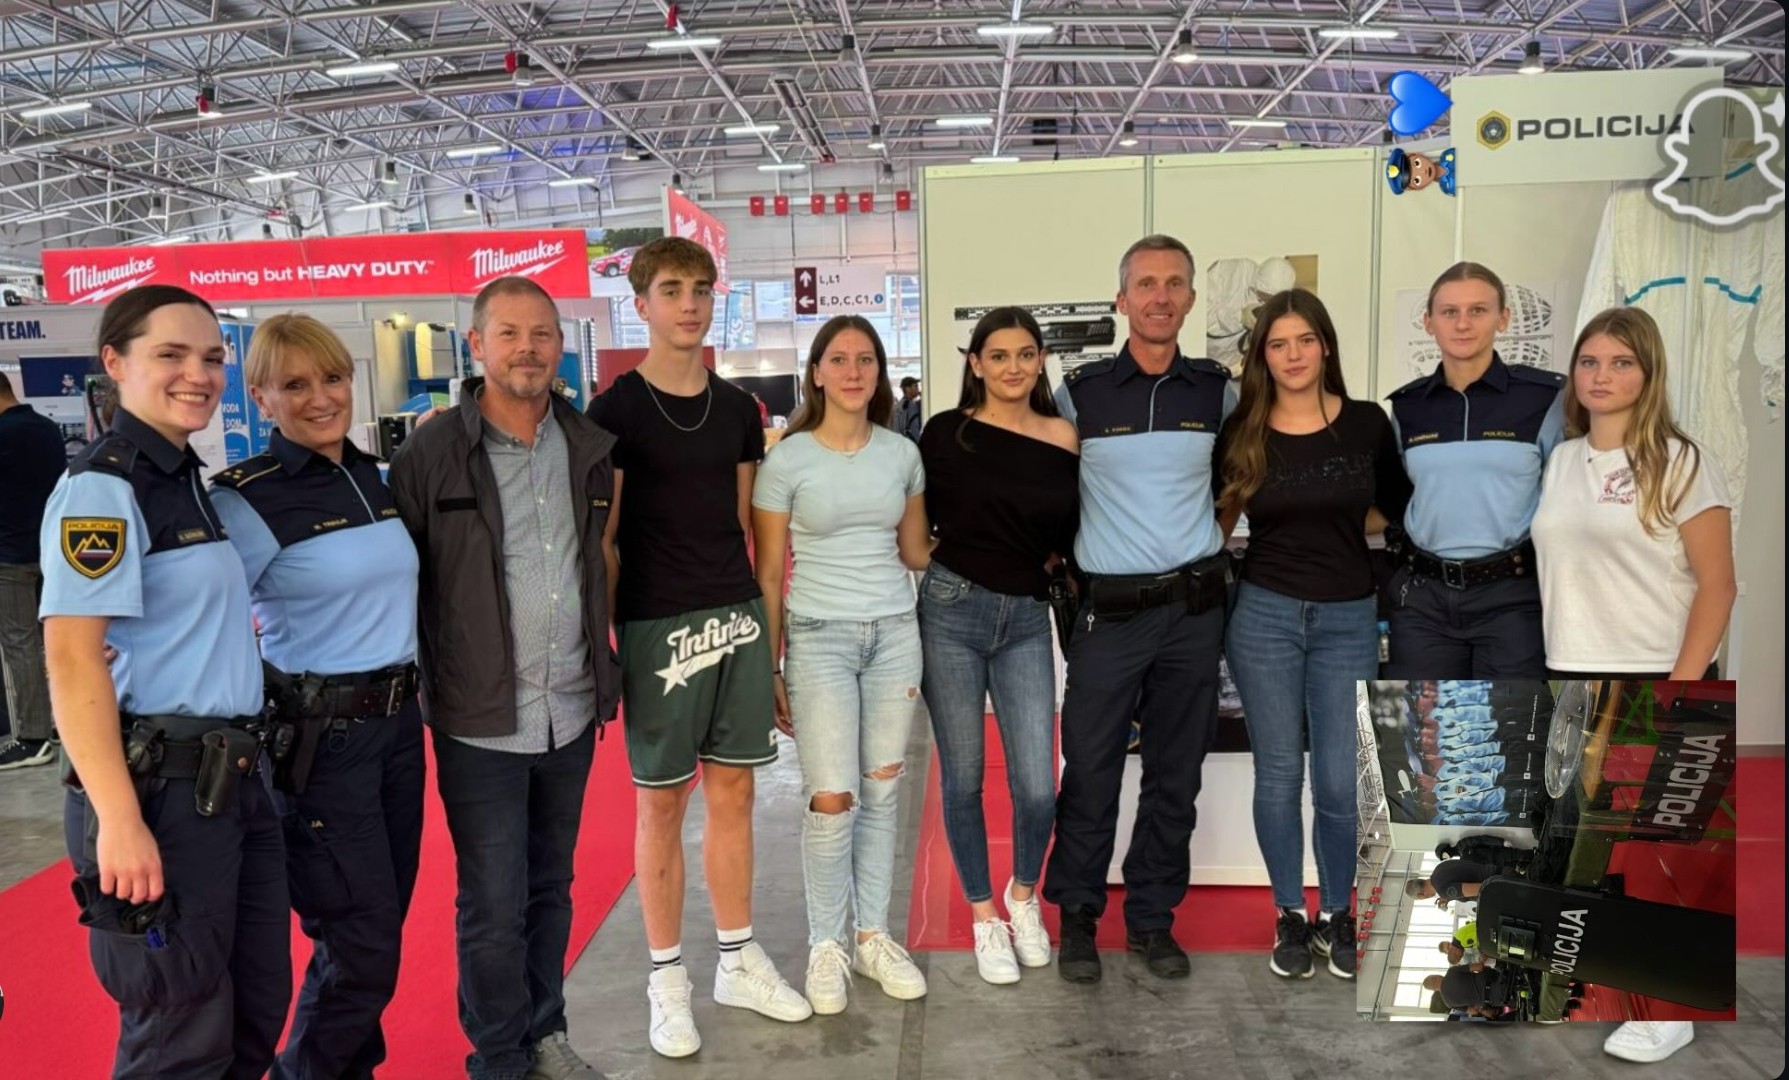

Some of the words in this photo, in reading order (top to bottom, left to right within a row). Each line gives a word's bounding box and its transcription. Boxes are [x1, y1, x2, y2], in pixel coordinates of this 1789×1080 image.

[1517, 113, 1695, 141] POLICIJA
[62, 256, 156, 296] Milwaukee
[189, 268, 259, 287] Nothing
[264, 265, 292, 282] but
[297, 261, 366, 280] HEAVY
[468, 239, 565, 279] Milwaukee
[666, 611, 758, 662] Infinite
[1652, 733, 1727, 829] POLICIJA
[1549, 908, 1589, 977] POLICIJA
